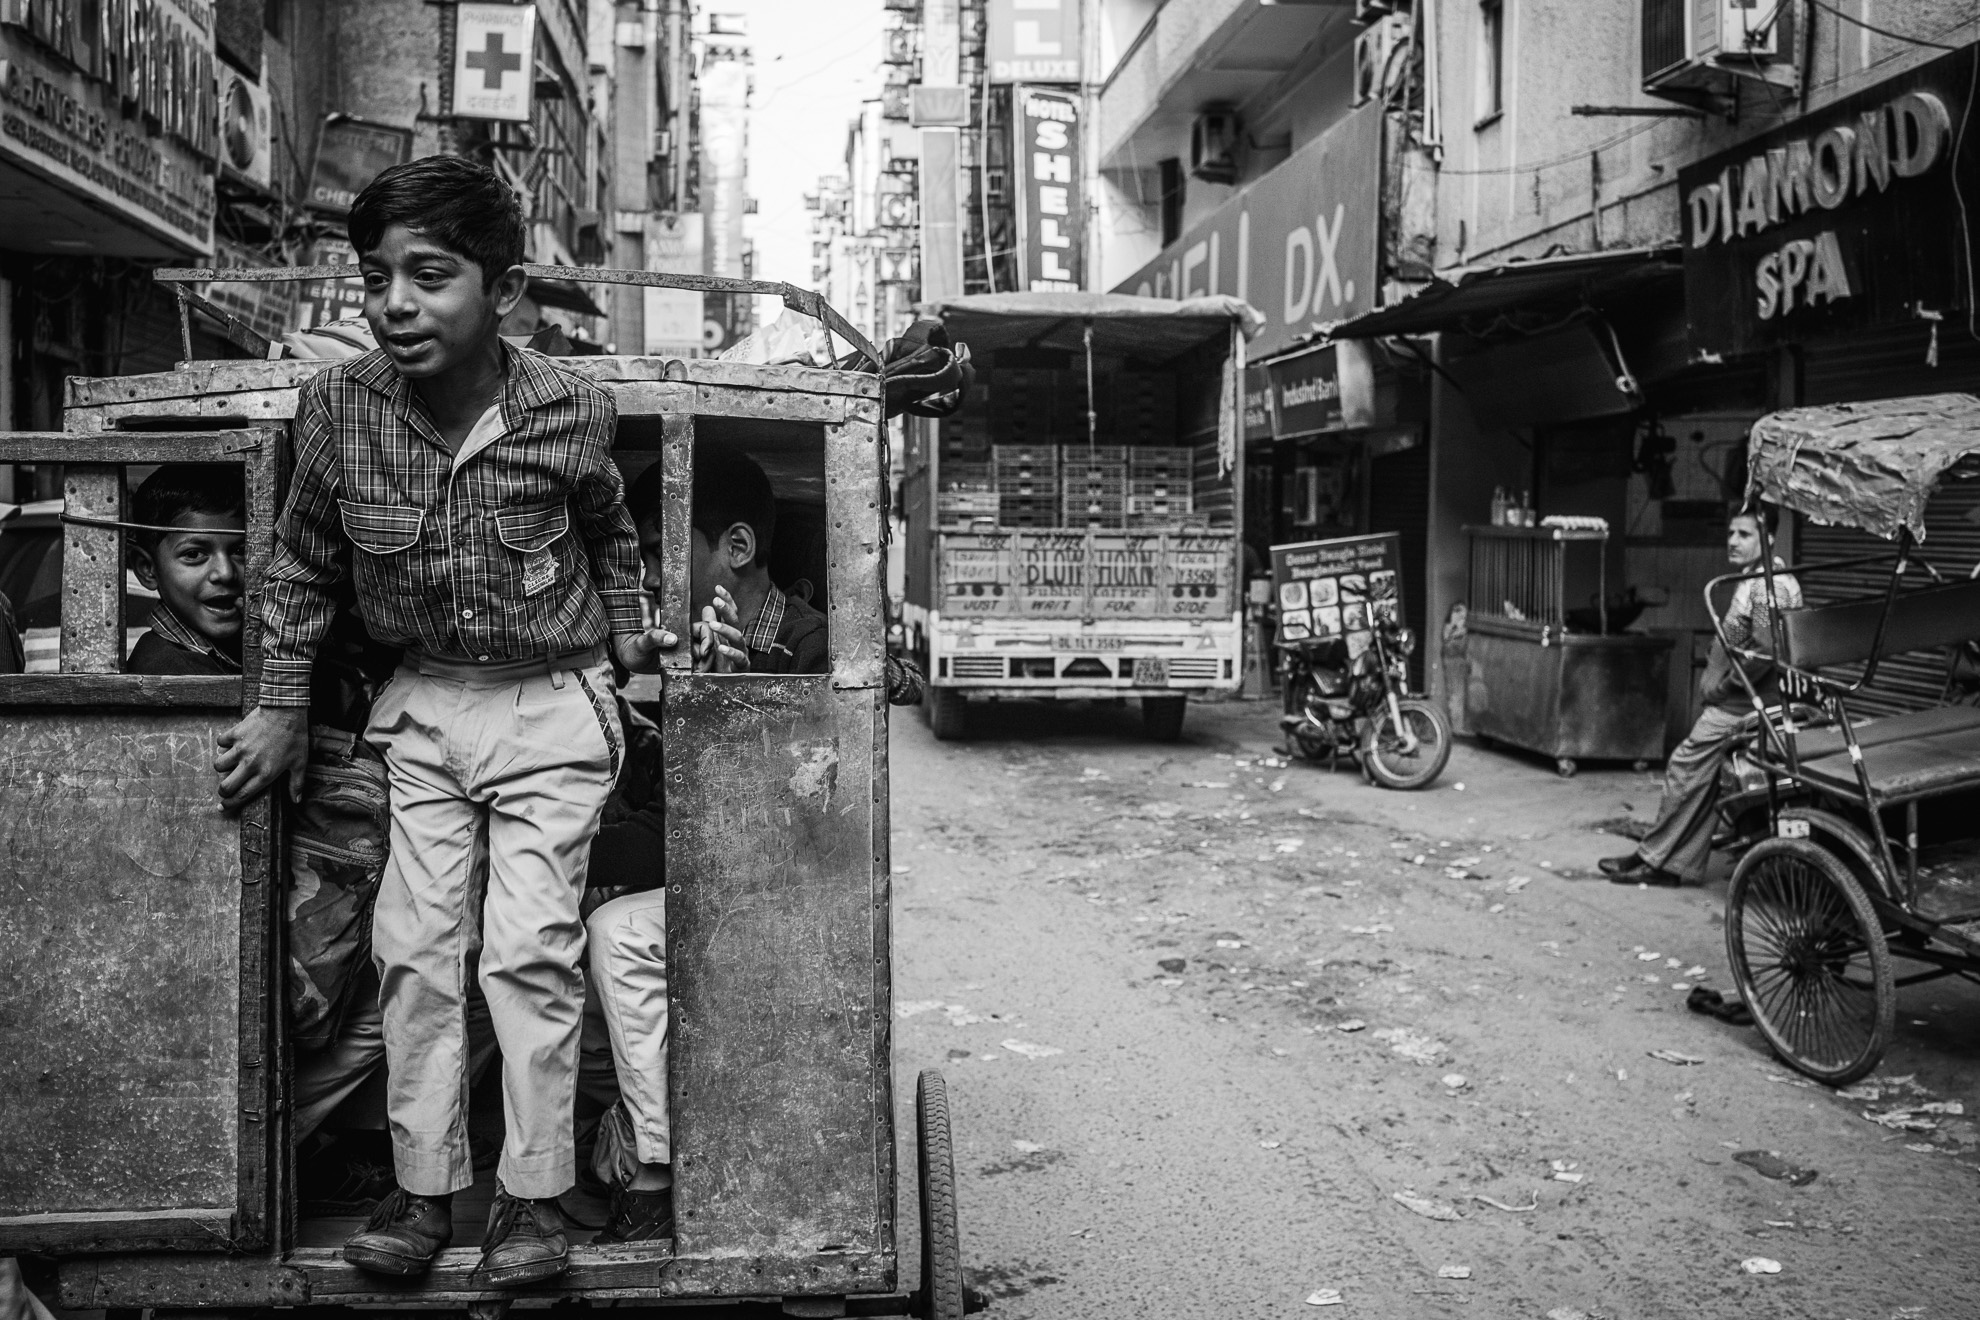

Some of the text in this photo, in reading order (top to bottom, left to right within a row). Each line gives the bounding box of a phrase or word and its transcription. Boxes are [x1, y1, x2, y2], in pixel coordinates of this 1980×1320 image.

[994, 60, 1079, 80] DELUXE
[1025, 98, 1077, 122] HOTEL
[1033, 120, 1072, 281] SHELL
[1687, 91, 1953, 249] DIAMOND
[1284, 203, 1355, 325] DX.
[1757, 231, 1850, 320] SPA
[1027, 550, 1084, 585] BLOW
[1098, 551, 1153, 586] HORN
[963, 600, 1210, 614] JUST WAIT FOR SIDE
